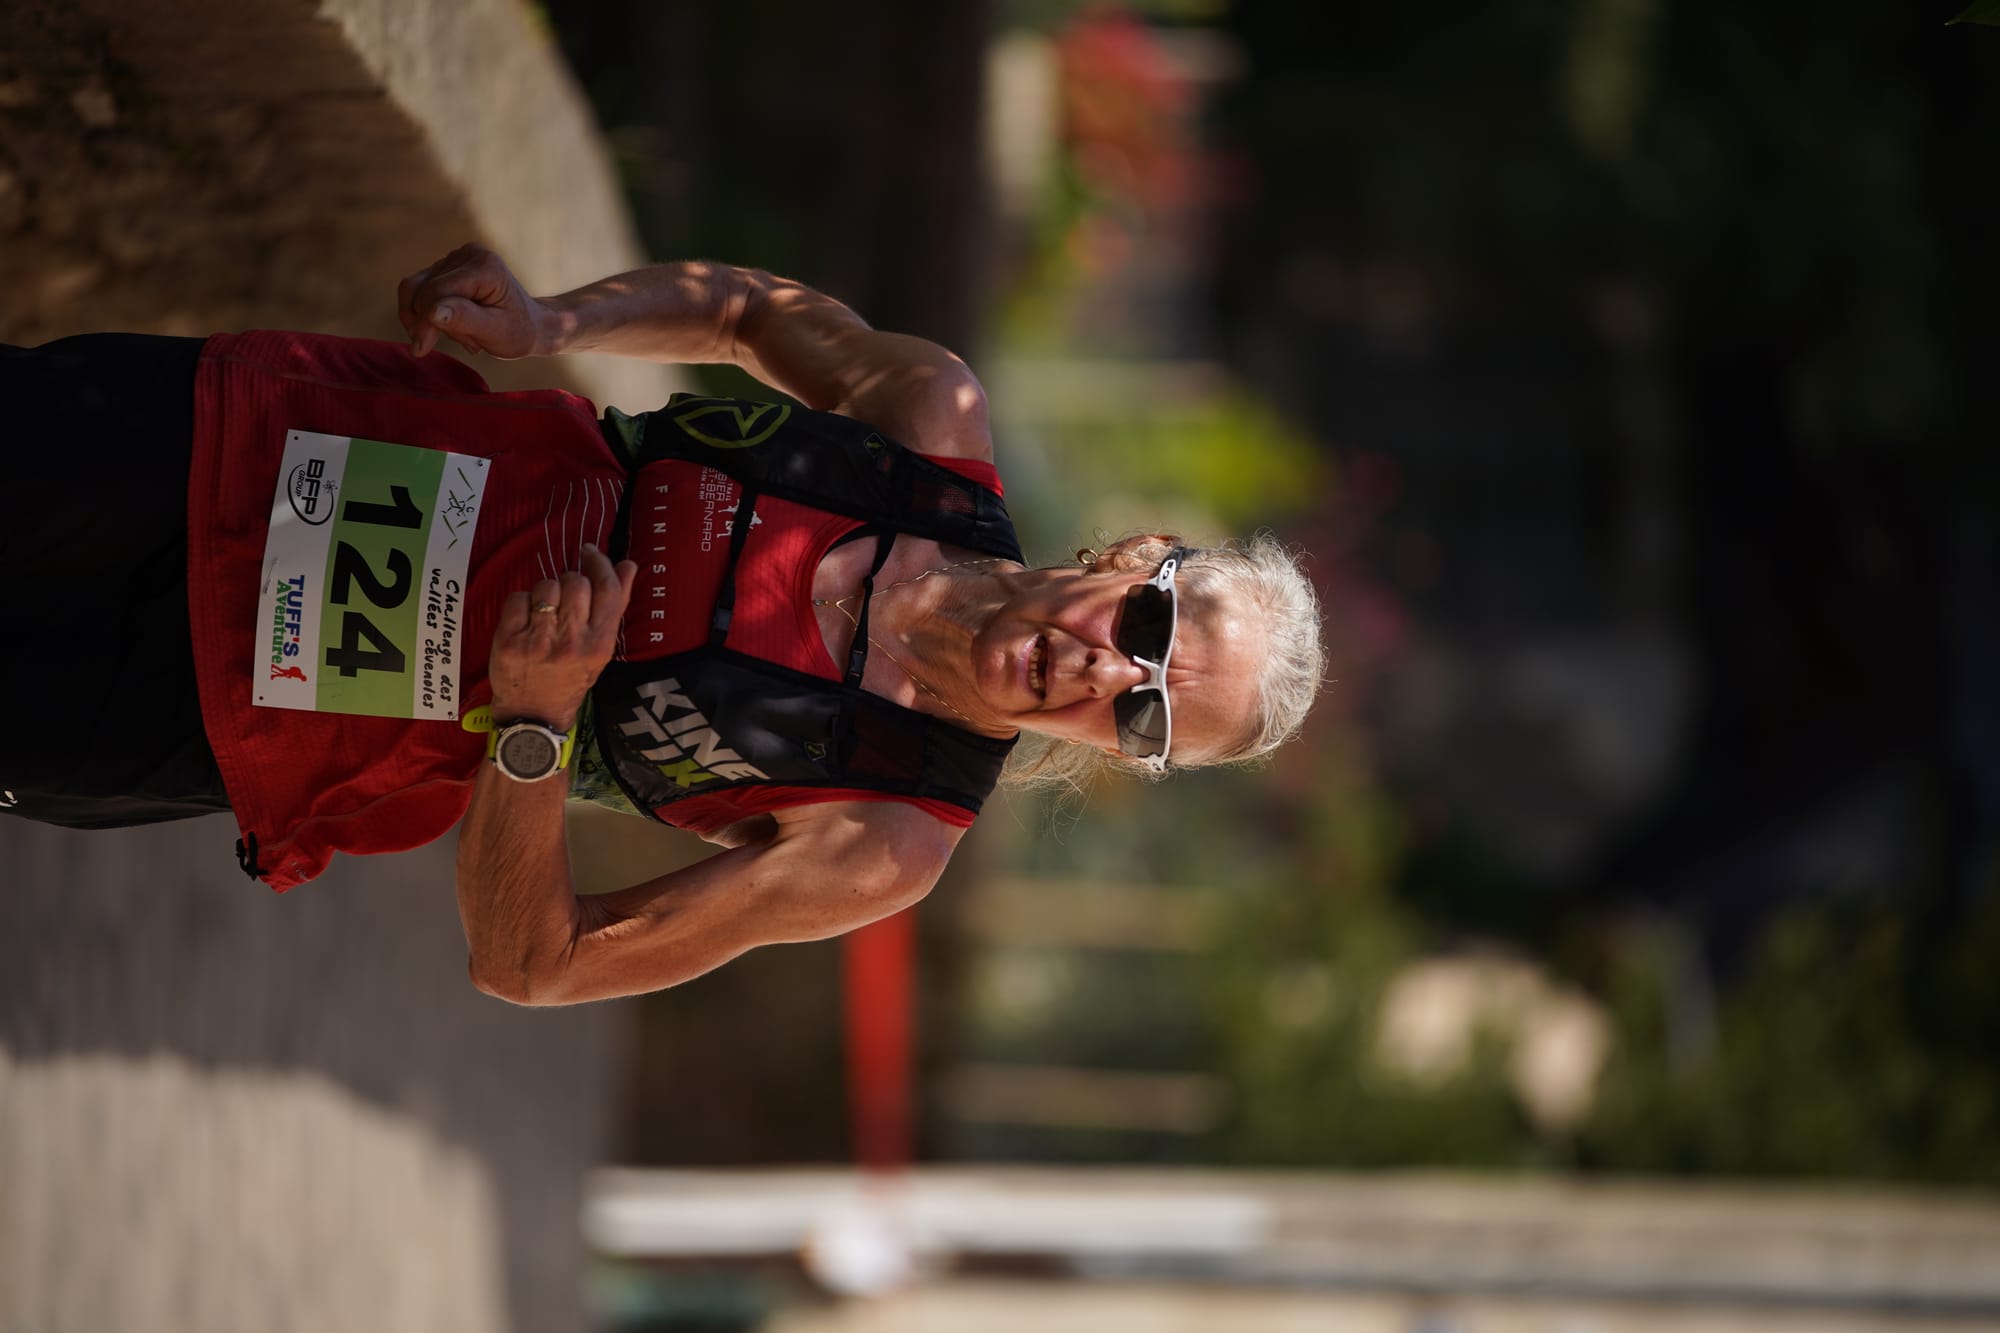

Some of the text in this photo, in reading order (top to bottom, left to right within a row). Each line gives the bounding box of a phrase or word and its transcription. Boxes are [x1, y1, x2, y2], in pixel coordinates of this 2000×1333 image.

[296, 469, 307, 498] GROUP
[301, 458, 326, 516] BFP
[716, 472, 728, 502] BIER
[325, 484, 424, 678] 124
[650, 484, 669, 643] FINISHER
[271, 579, 292, 665] Aventure
[283, 575, 305, 657] TUFF'S
[422, 568, 442, 710] vallées cévenoles
[437, 579, 460, 703] Challenge des
[619, 705, 720, 789] TIK
